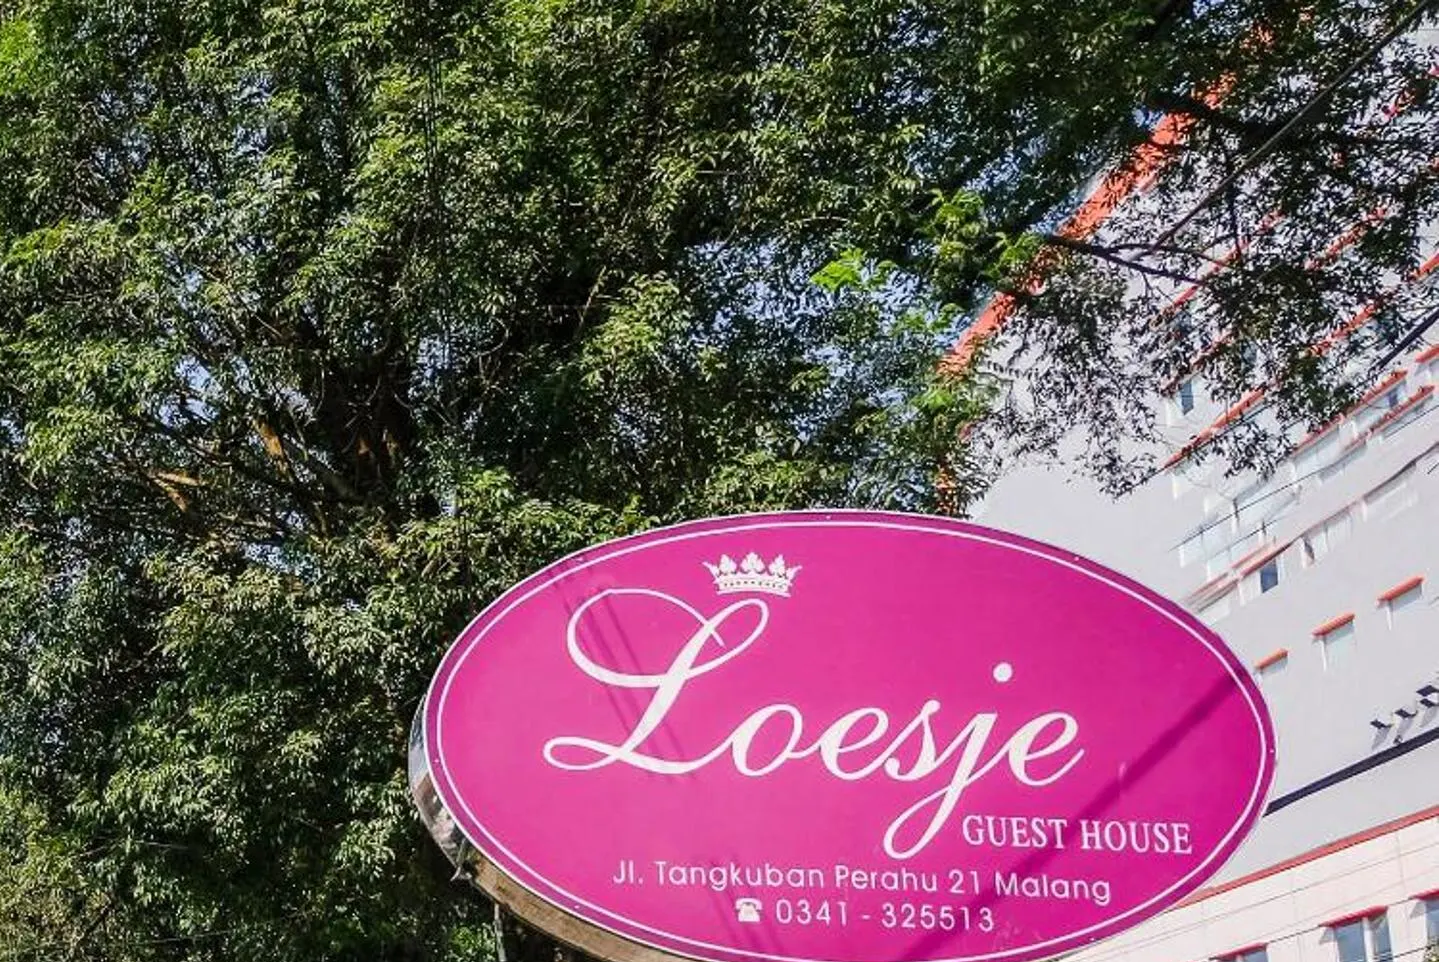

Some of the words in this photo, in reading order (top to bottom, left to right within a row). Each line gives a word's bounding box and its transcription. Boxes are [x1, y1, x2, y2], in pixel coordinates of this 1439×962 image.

[544, 588, 1084, 859] Loesje
[962, 815, 1067, 849] GUEST
[1081, 820, 1192, 854] HOUSE
[613, 860, 644, 885] Jl.
[654, 861, 824, 891] Tangkuban
[835, 865, 938, 893] Perahu
[948, 869, 981, 894] 21
[995, 872, 1110, 906] Malang
[775, 899, 848, 926] 0341
[881, 903, 994, 931] 325513
